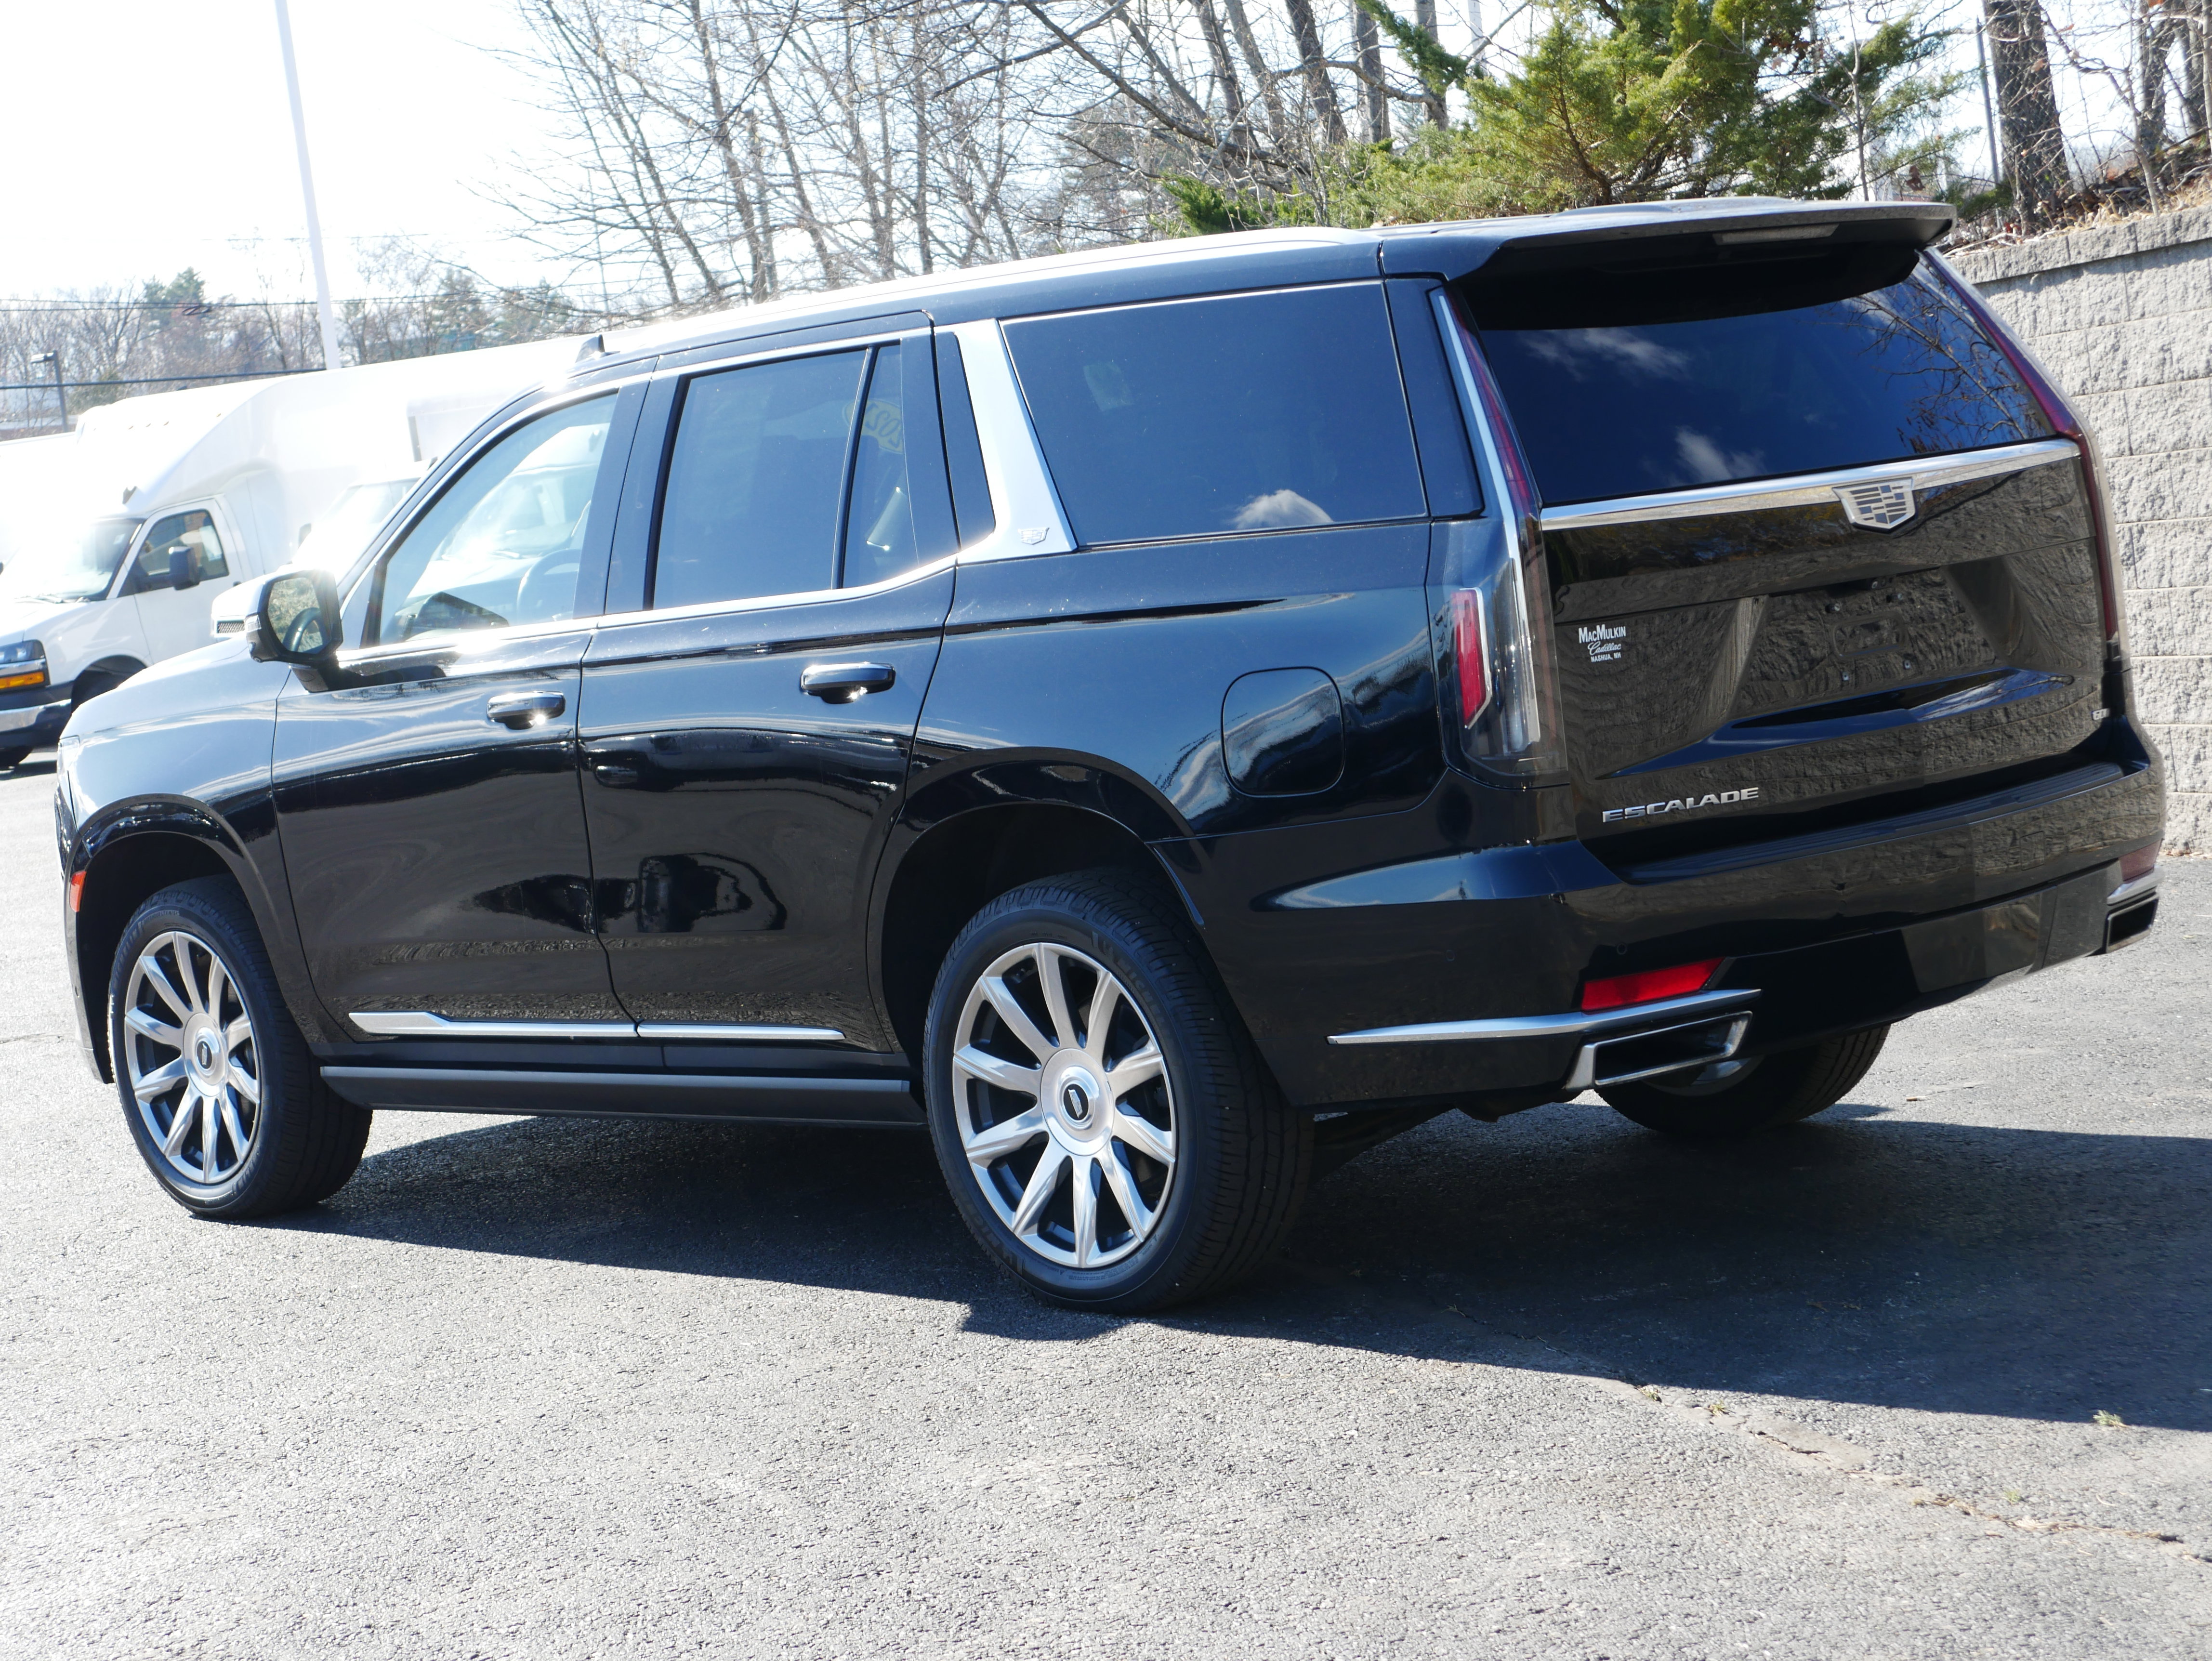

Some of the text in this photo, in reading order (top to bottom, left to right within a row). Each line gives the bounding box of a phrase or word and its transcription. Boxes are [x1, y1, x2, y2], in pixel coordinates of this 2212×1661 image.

[1588, 641, 1621, 655] Cadillac
[1591, 654, 1613, 662] NASHUA,
[1602, 787, 1759, 823] ESCALADE
